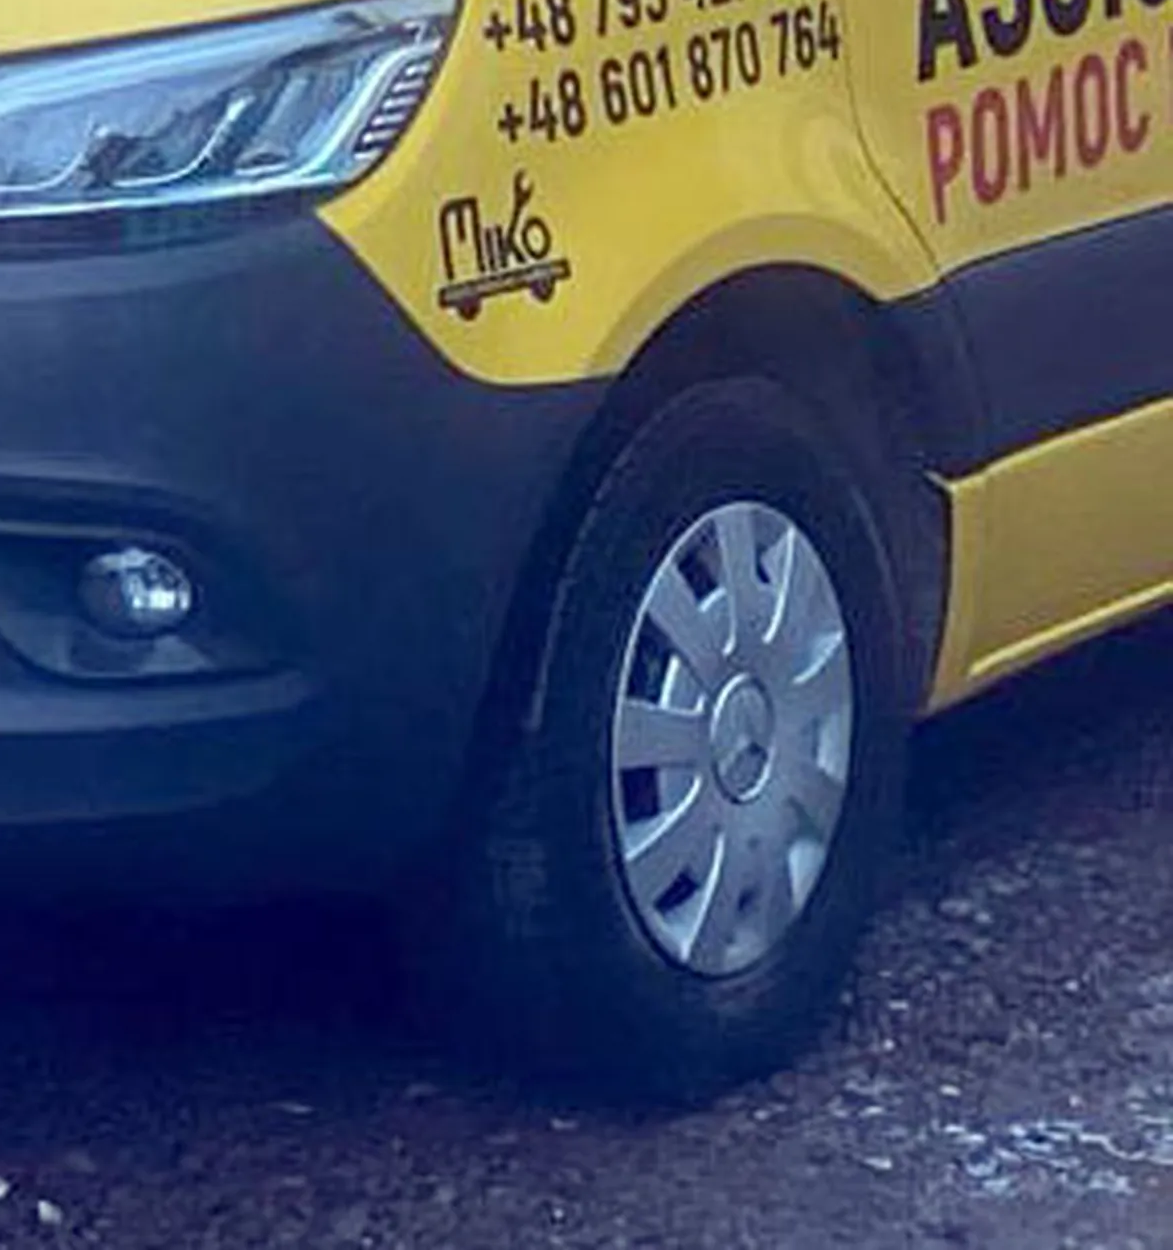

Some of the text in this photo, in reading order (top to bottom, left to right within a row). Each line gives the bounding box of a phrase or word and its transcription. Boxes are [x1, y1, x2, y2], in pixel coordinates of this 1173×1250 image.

[497, 0, 841, 143] +48 601 870 764
[928, 37, 1151, 225] POMOC
